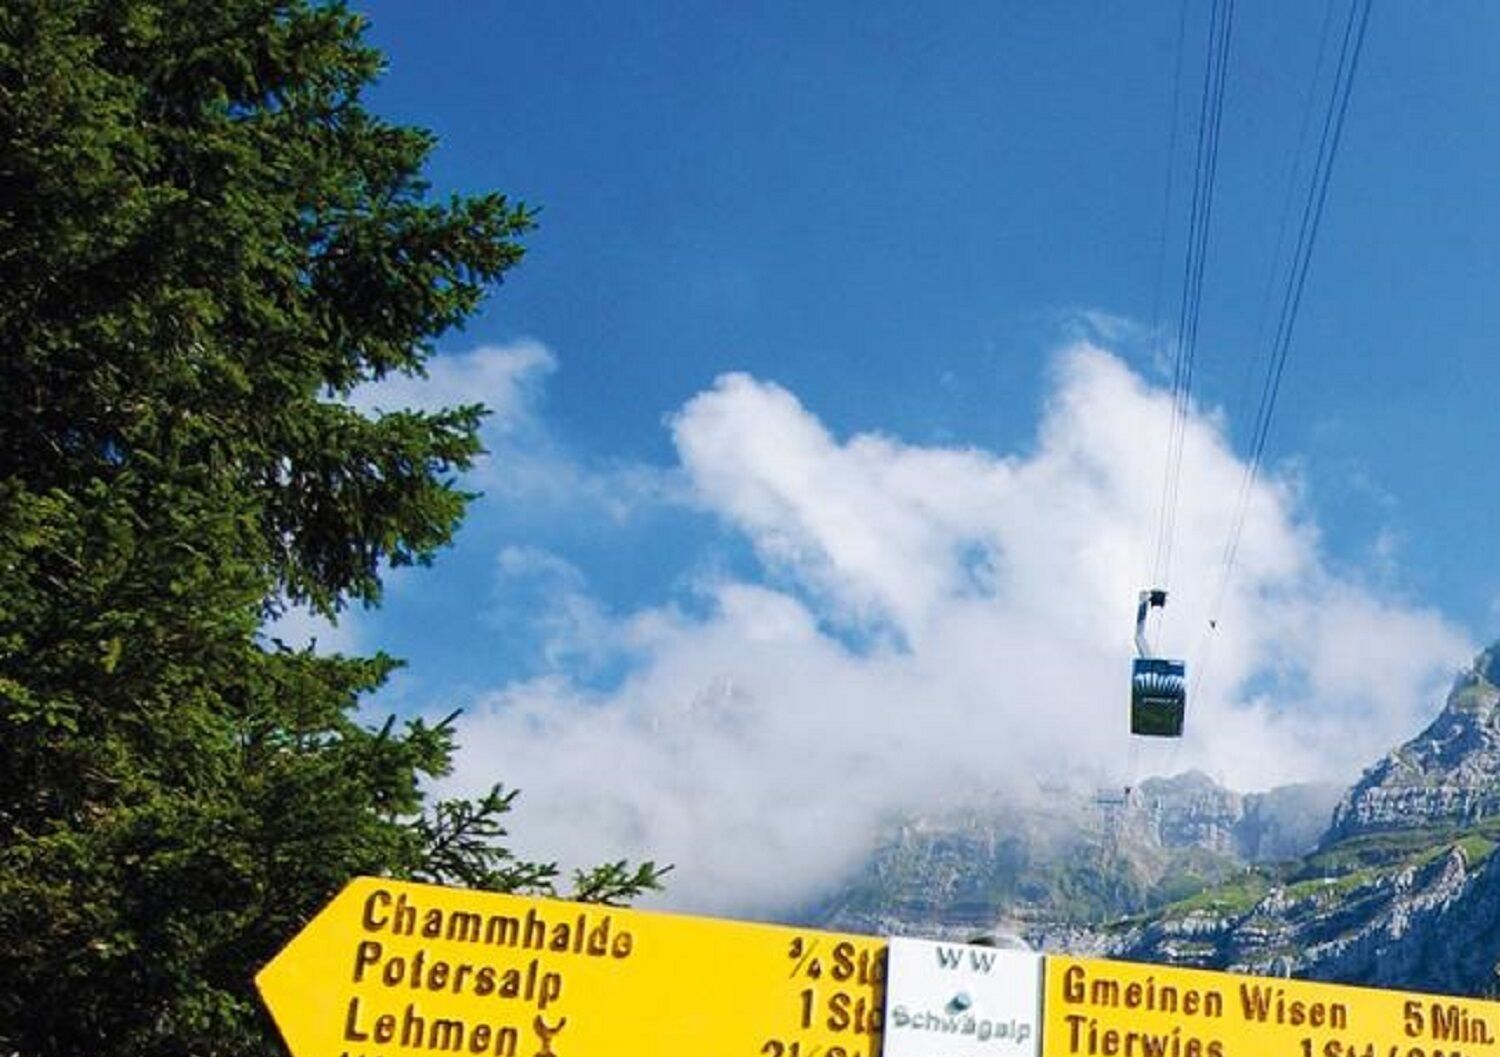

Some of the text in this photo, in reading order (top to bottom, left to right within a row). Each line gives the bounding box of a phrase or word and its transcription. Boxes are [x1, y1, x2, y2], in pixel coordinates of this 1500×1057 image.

[363, 888, 633, 959] Chammhalde
[353, 941, 562, 1003] Potersalp
[801, 988, 813, 1029] 1
[1063, 964, 1496, 1046] Gmeinen Wisen 5 Min.
[344, 998, 517, 1057] Lehmen
[892, 1005, 1031, 1043] Schwägalp
